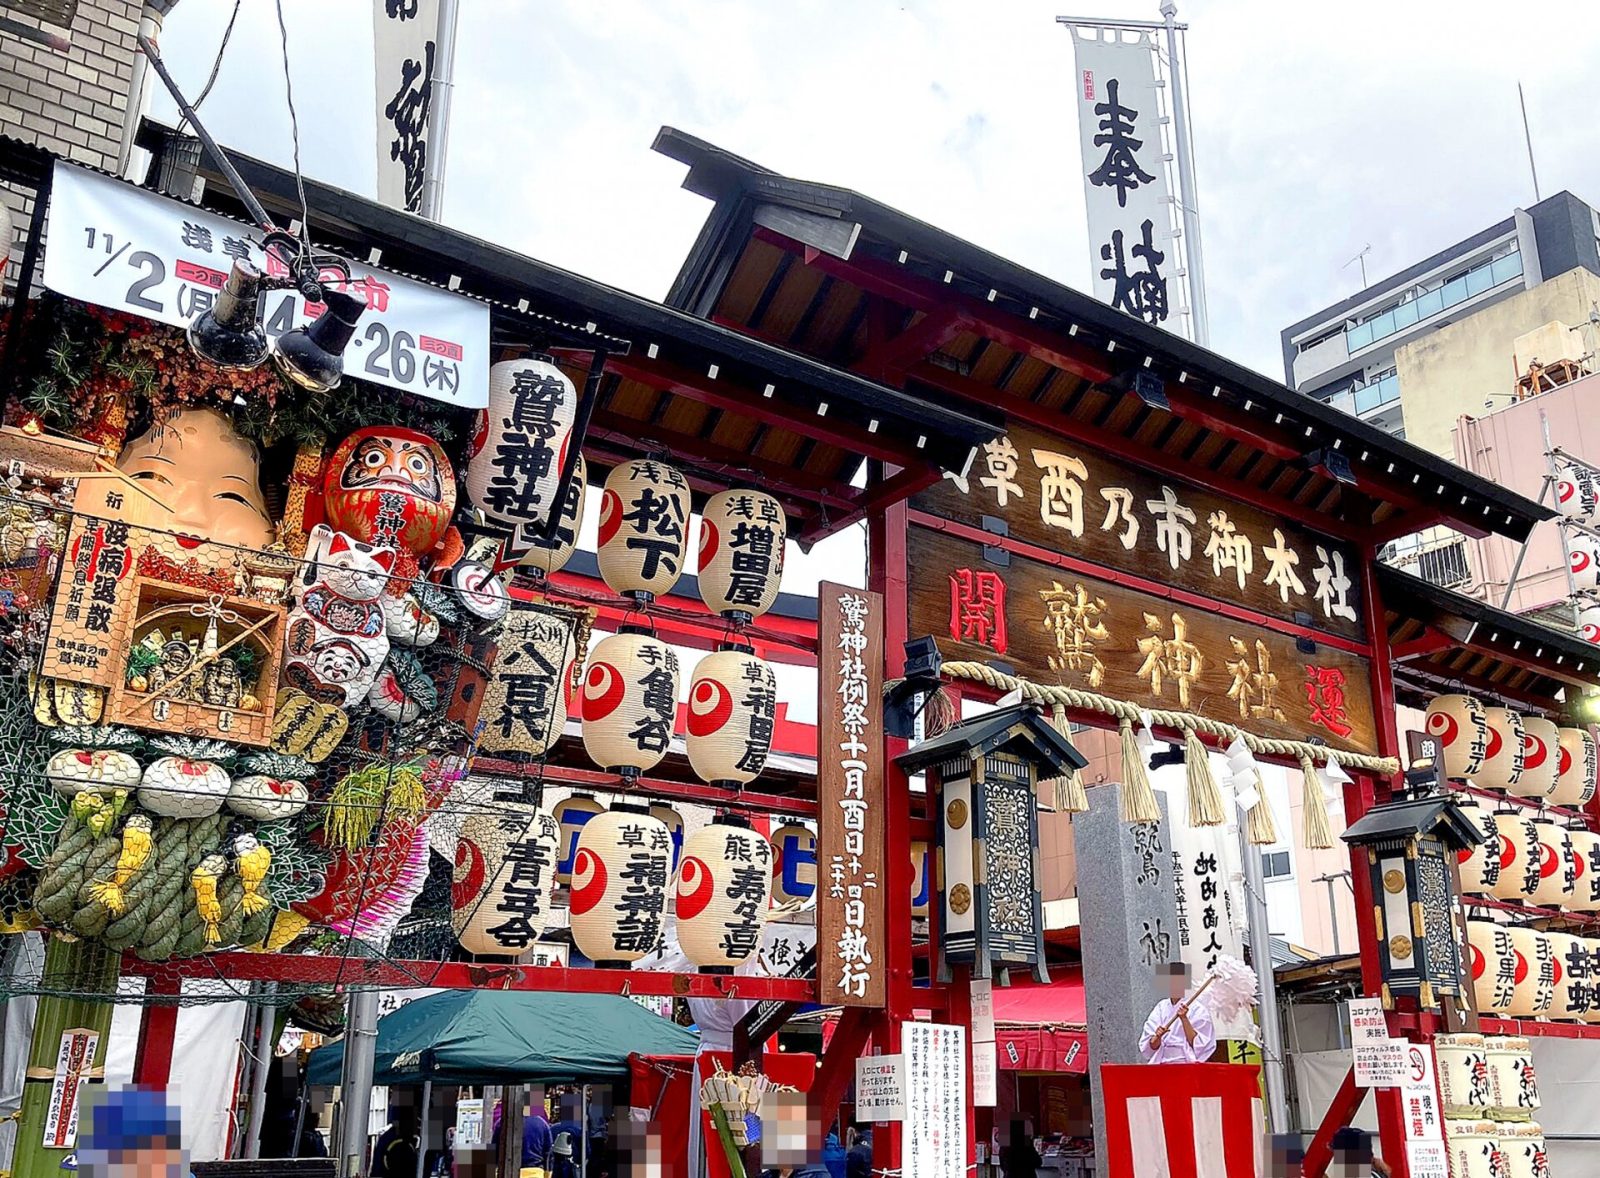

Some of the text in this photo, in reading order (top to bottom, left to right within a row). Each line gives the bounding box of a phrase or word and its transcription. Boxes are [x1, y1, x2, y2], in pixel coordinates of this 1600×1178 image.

[181, 221, 252, 261] 浅草
[483, 369, 565, 521] 鷲神社
[630, 461, 687, 490] 浅草
[622, 488, 685, 581] 松下
[725, 495, 780, 524] 浅草
[941, 436, 1358, 623] 草酉乃市御本社
[84, 519, 130, 634] 疫病退散
[724, 522, 775, 608] 増田屋
[948, 567, 1008, 656] 開
[628, 666, 675, 755] 亀谷
[734, 686, 776, 775] 福田屋
[1305, 664, 1352, 739] 運
[724, 834, 772, 866] 熊手
[718, 865, 768, 960] 寿々喜
